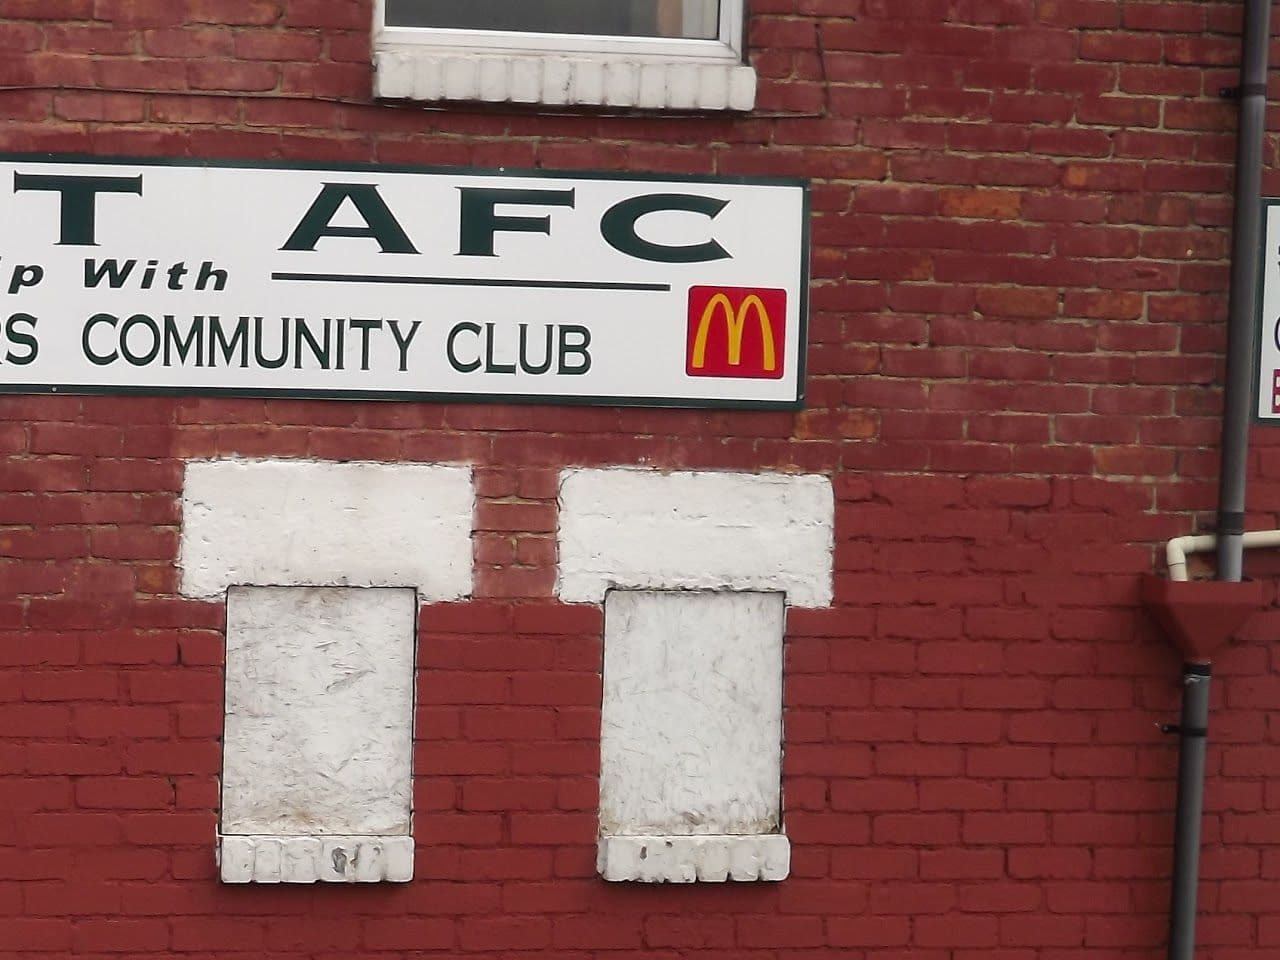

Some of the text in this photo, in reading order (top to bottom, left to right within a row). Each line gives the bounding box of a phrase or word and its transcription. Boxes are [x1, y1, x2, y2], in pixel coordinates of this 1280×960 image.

[277, 182, 734, 264] AFC
[84, 258, 228, 291] With
[81, 313, 422, 372] COMMUNITY
[446, 321, 592, 376] CLUB
